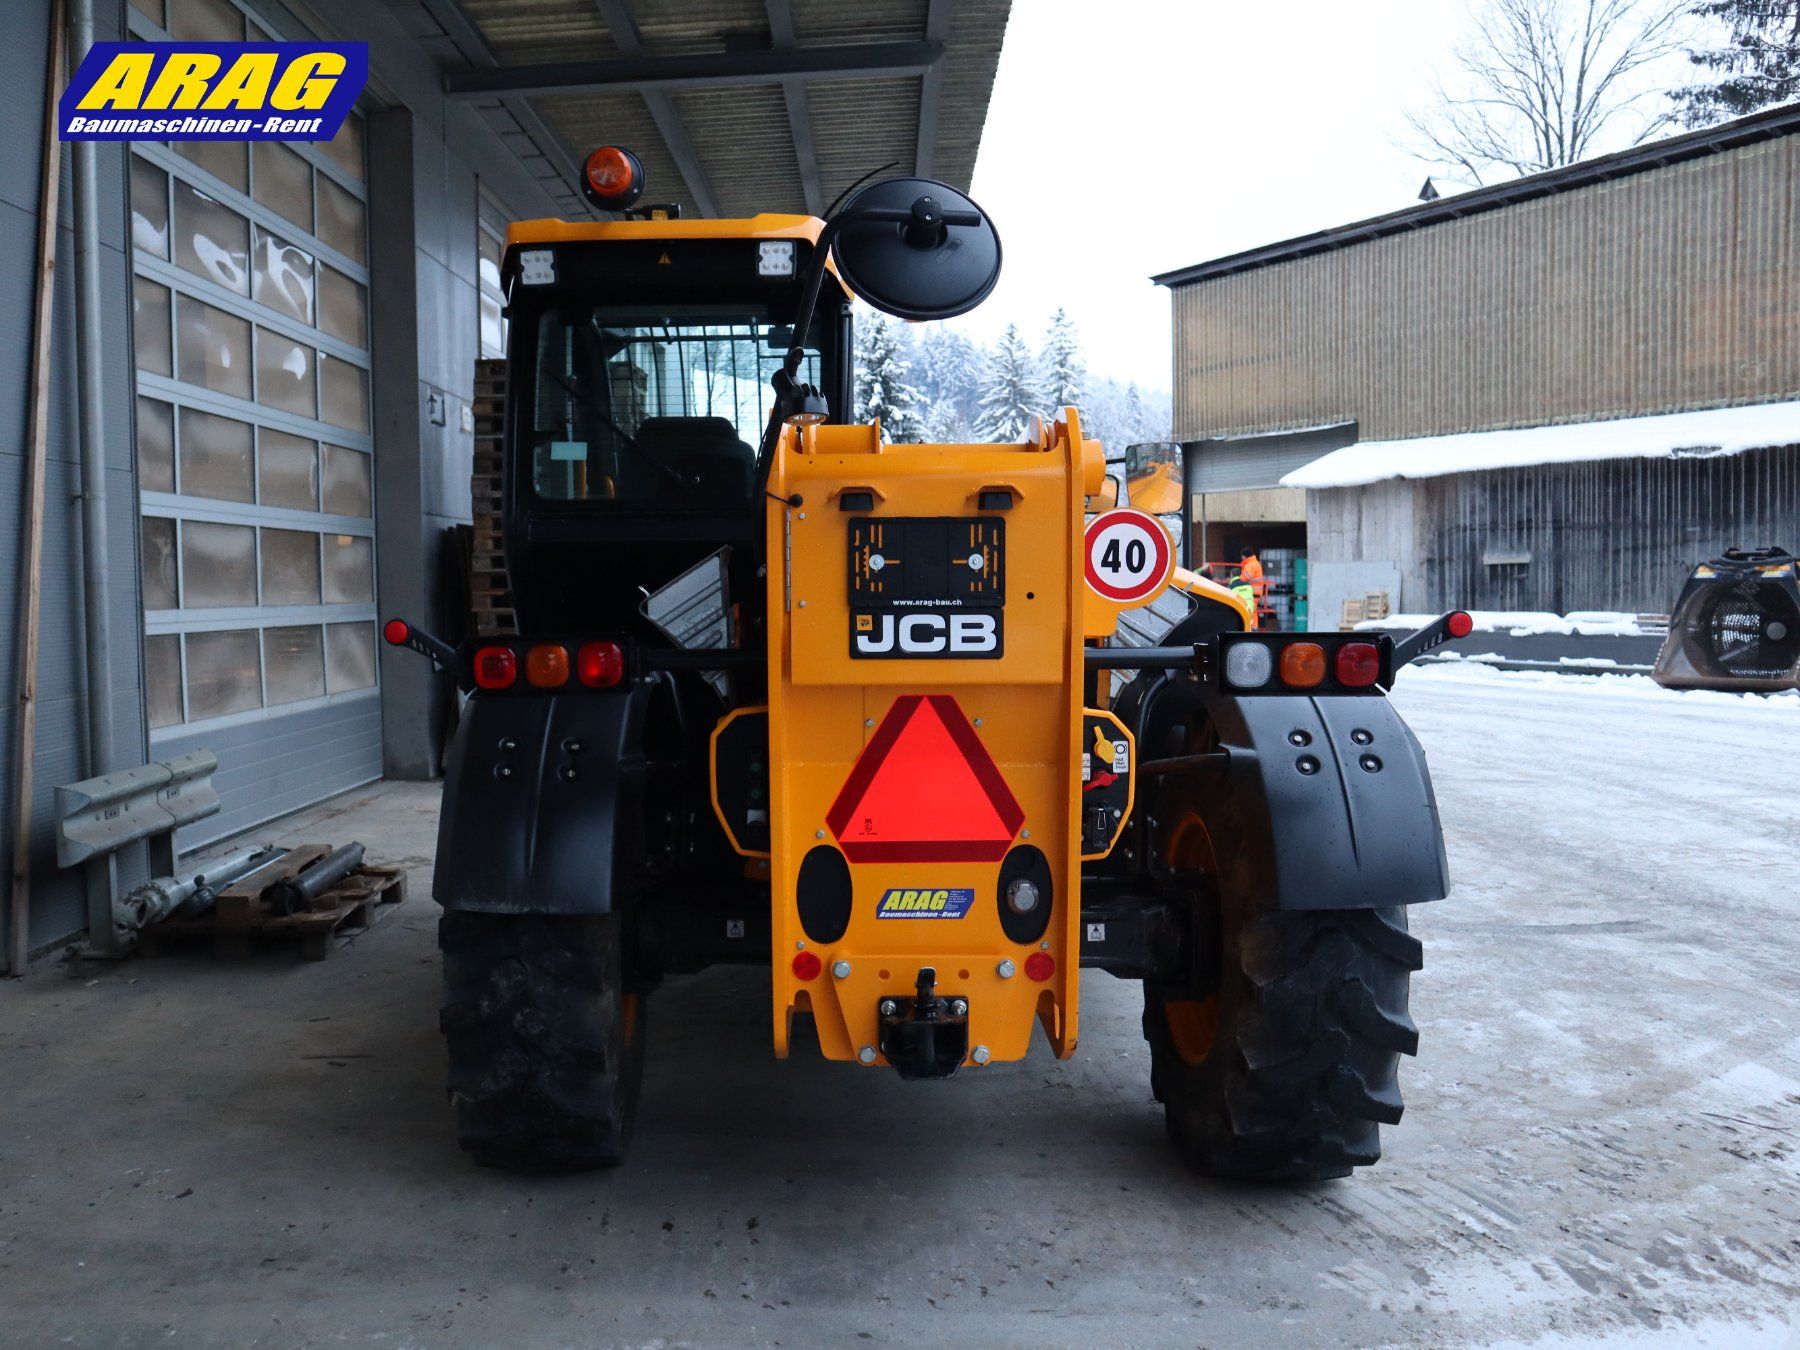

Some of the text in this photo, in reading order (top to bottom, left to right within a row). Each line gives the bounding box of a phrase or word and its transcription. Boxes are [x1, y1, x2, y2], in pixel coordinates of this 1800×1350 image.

[1101, 539, 1146, 573] 40
[893, 599, 962, 607] www.arag-bau.ch
[857, 614, 997, 652] JCB
[882, 890, 949, 910] ARAG
